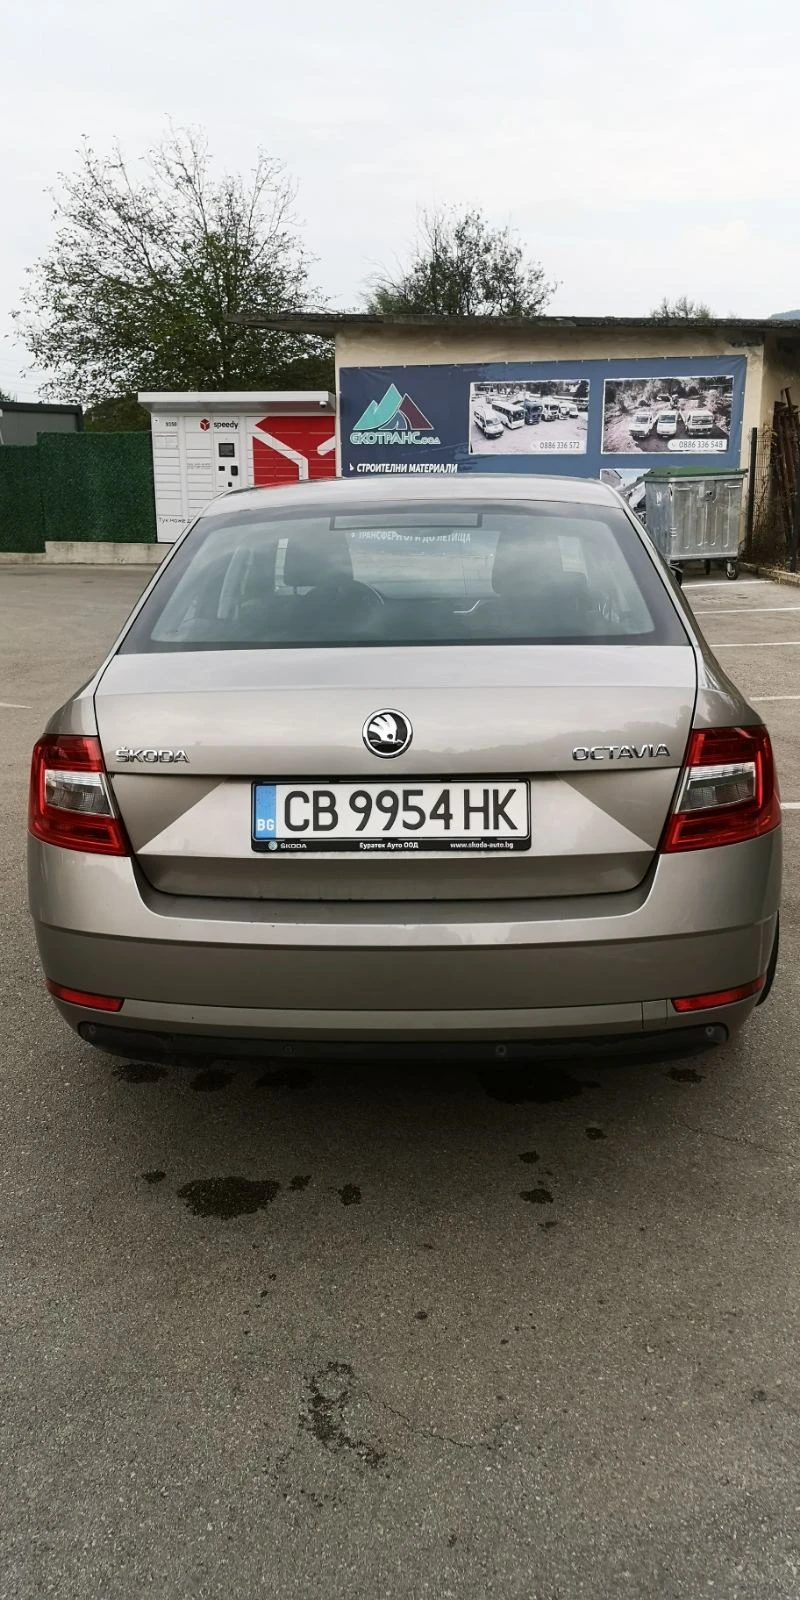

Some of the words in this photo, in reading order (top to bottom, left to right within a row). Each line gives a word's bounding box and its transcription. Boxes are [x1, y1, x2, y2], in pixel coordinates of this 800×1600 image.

[213, 420, 239, 430] speedy
[539, 441, 556, 449] 0886
[556, 441, 568, 449] 336
[569, 441, 580, 449] 572
[678, 440, 696, 448] 0886
[697, 440, 709, 448] 336
[710, 440, 723, 448] 548
[356, 463, 407, 473] СТРОИТЕЛНИ
[408, 463, 458, 473] МАТЕРИАЛИ
[115, 746, 190, 764] ŠKODA
[571, 743, 671, 761] OCTAVIA
[284, 789, 339, 831] CB
[349, 789, 453, 831] 9954
[463, 788, 518, 830] HK
[257, 819, 275, 831] BG
[386, 841, 402, 850] Ауто
[404, 841, 419, 849] ООД
[449, 841, 514, 850] www.skoda-auto.bg
